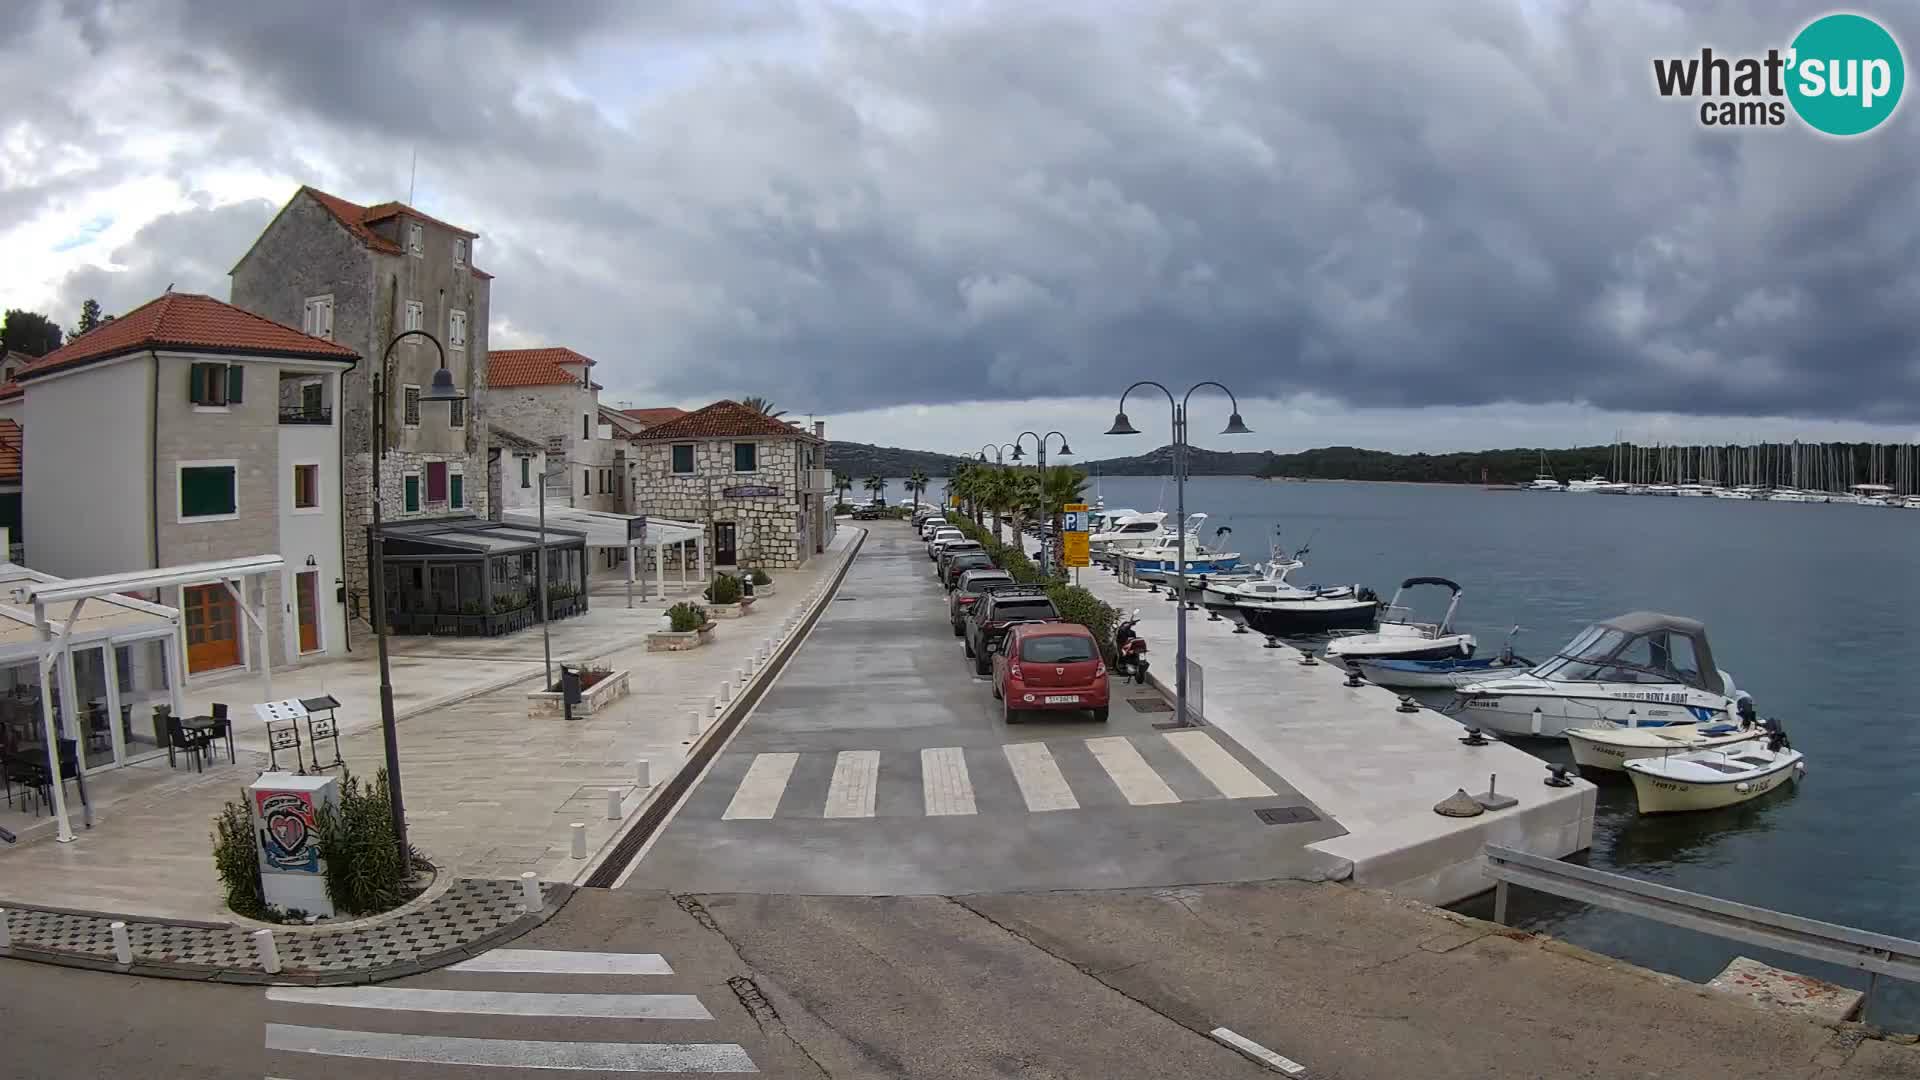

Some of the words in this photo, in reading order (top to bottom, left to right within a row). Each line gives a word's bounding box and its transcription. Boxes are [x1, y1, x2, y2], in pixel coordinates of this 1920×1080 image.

[1066, 513, 1076, 530] P
[1646, 692, 1664, 702] RENT
[1665, 693, 1670, 702] A
[1671, 693, 1688, 704] BOAT
